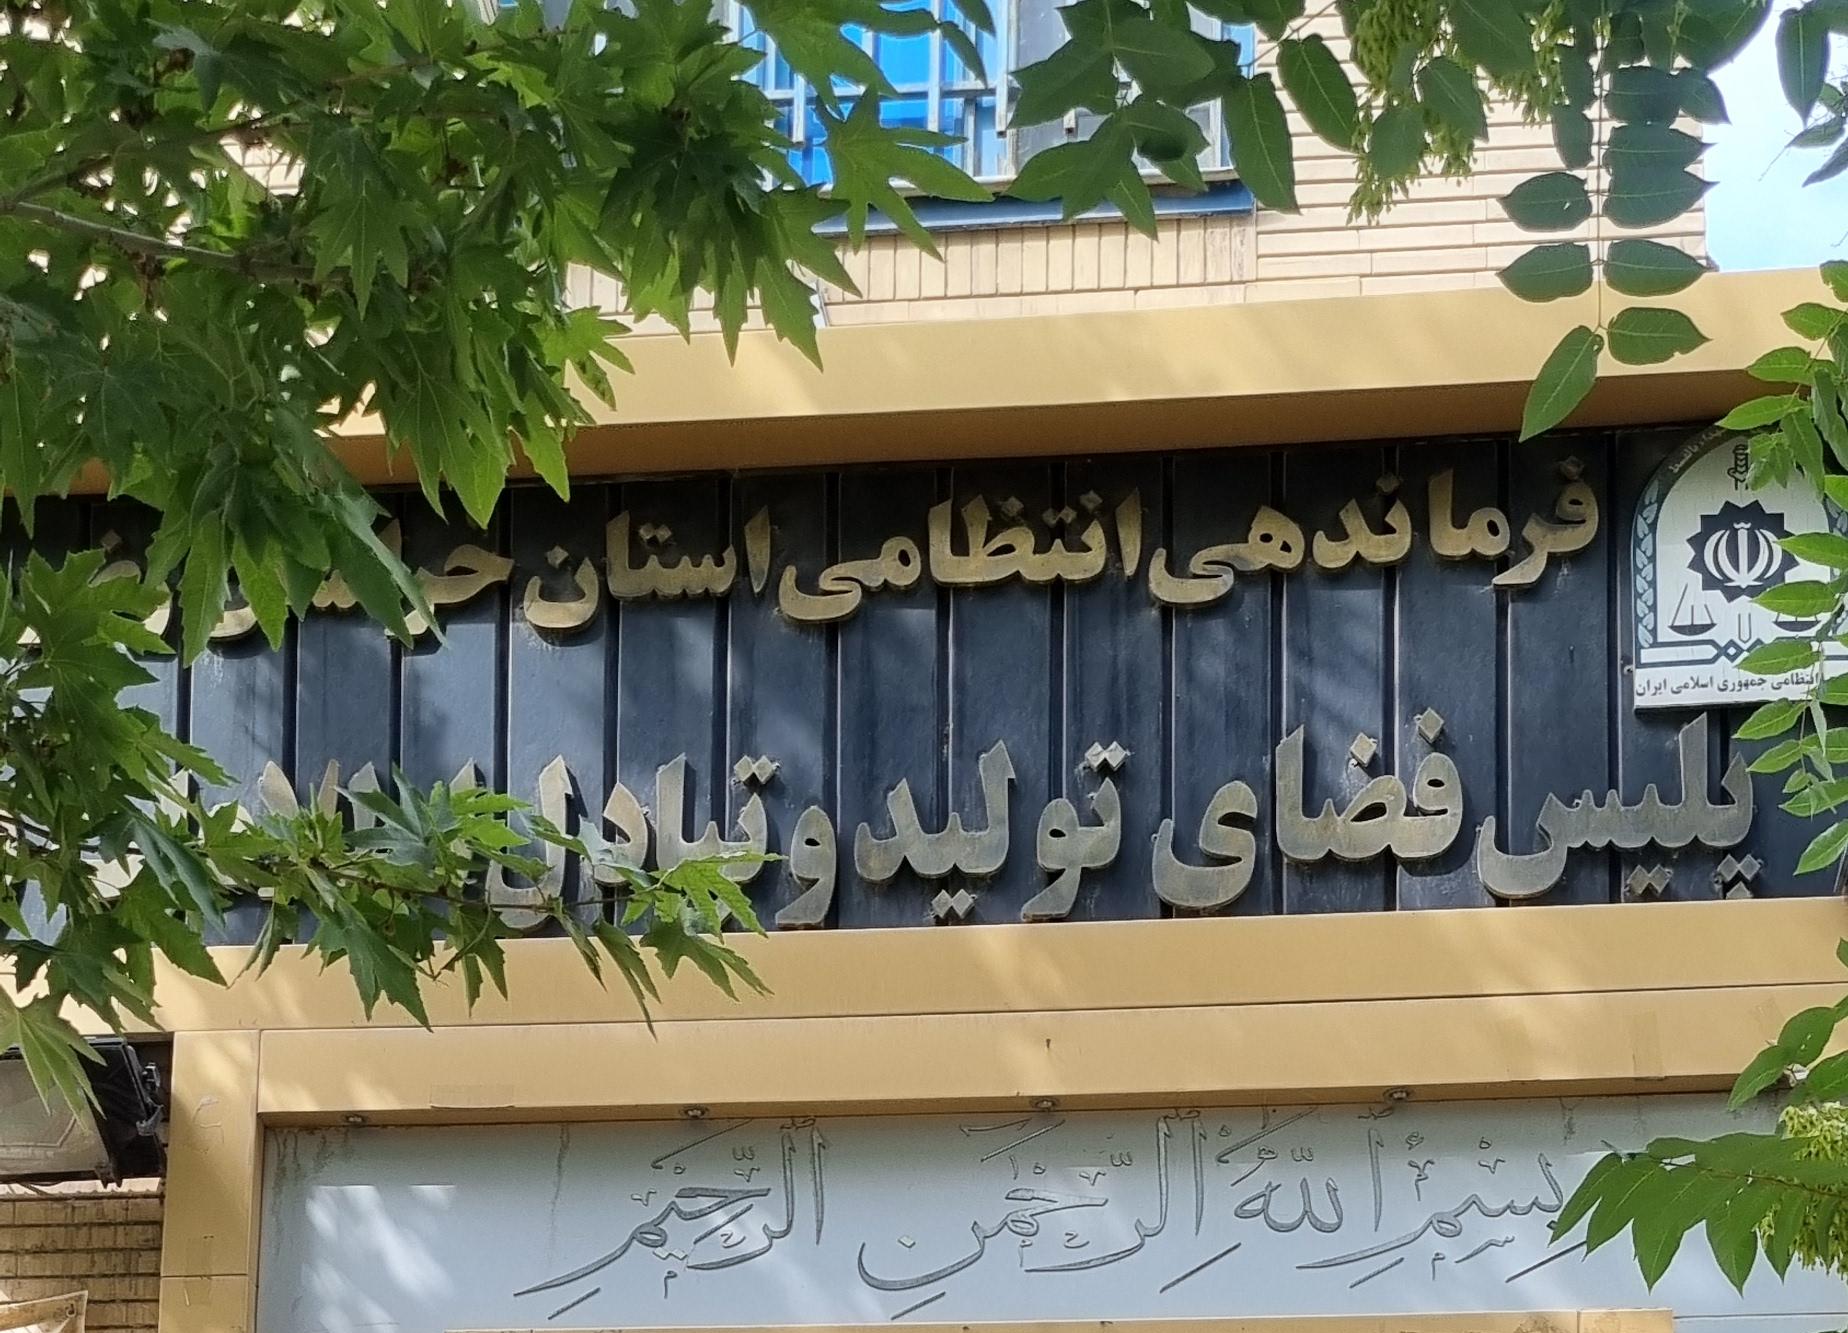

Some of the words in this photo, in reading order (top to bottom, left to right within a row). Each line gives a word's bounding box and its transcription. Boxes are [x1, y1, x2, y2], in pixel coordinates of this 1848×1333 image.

[522, 506, 773, 631] استان
[779, 487, 1142, 622] انتظامی
[1149, 455, 1600, 606] فرماندهی
[1635, 678, 1667, 697] ایران
[1671, 676, 1713, 695] اسلامی
[1716, 677, 1767, 693] جمهوری
[775, 805, 837, 928] و
[854, 738, 1131, 921] تولید
[1152, 708, 1464, 909] فضای
[1477, 712, 1754, 898] پلیس
